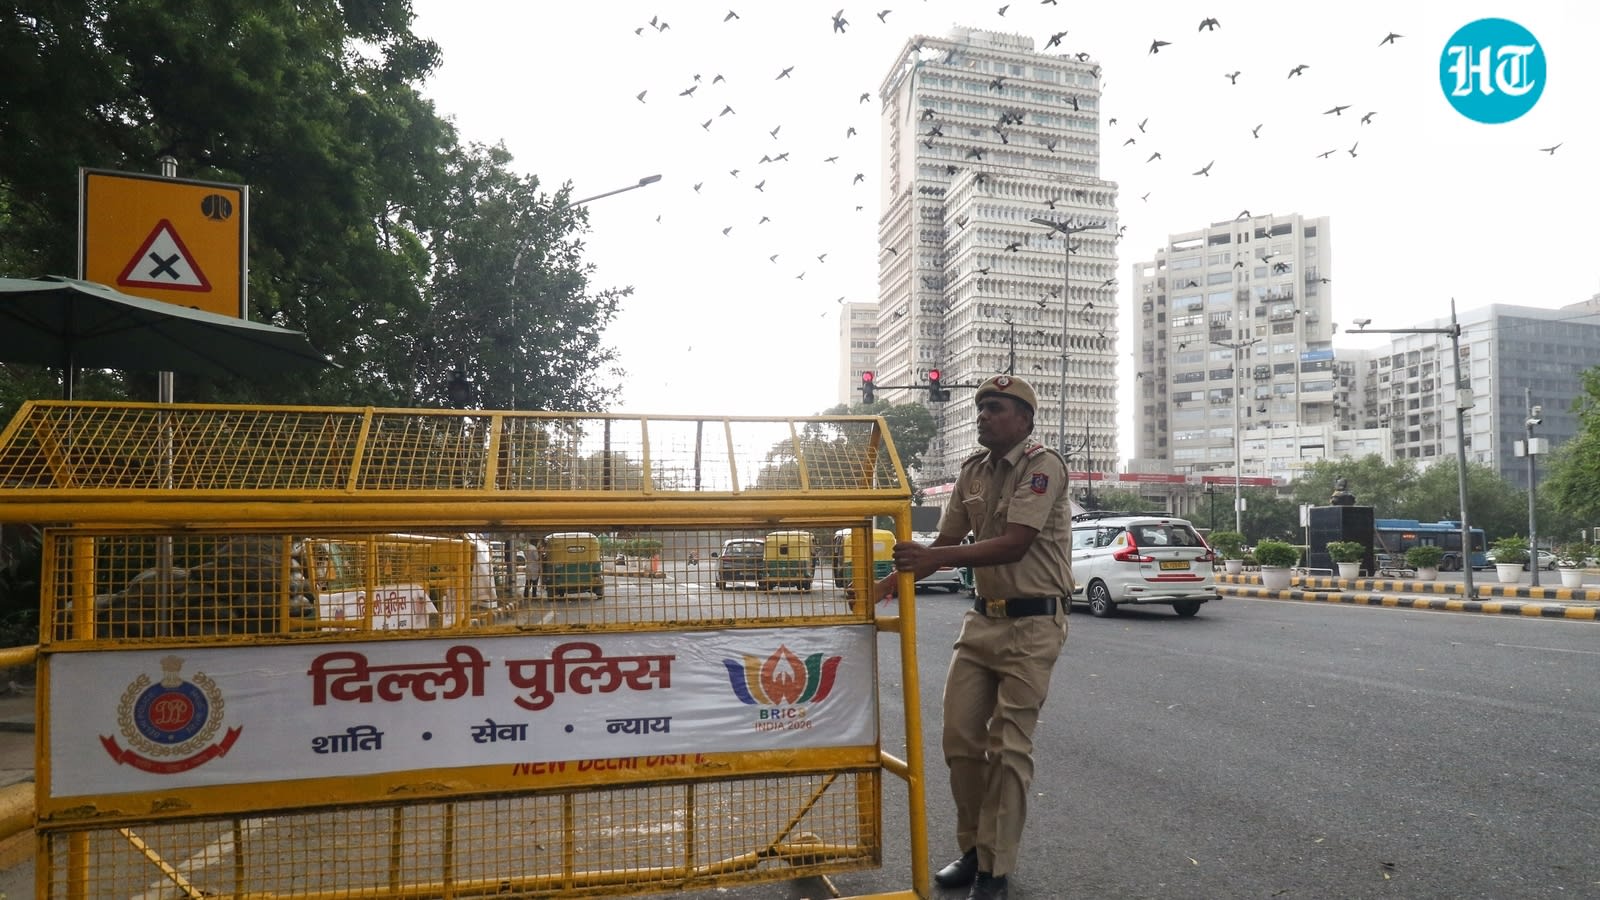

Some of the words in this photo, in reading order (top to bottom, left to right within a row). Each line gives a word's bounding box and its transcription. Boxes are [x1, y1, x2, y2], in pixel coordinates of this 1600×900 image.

[357, 595, 383, 617] दिली
[307, 645, 490, 706] दिल्ली
[506, 641, 676, 711] पुलिस
[760, 707, 806, 720] BRICS
[311, 725, 384, 754] शांति
[471, 717, 528, 744] सेवा
[606, 716, 673, 735] न्याय
[755, 720, 785, 732] INDIA
[788, 719, 813, 731] 2026
